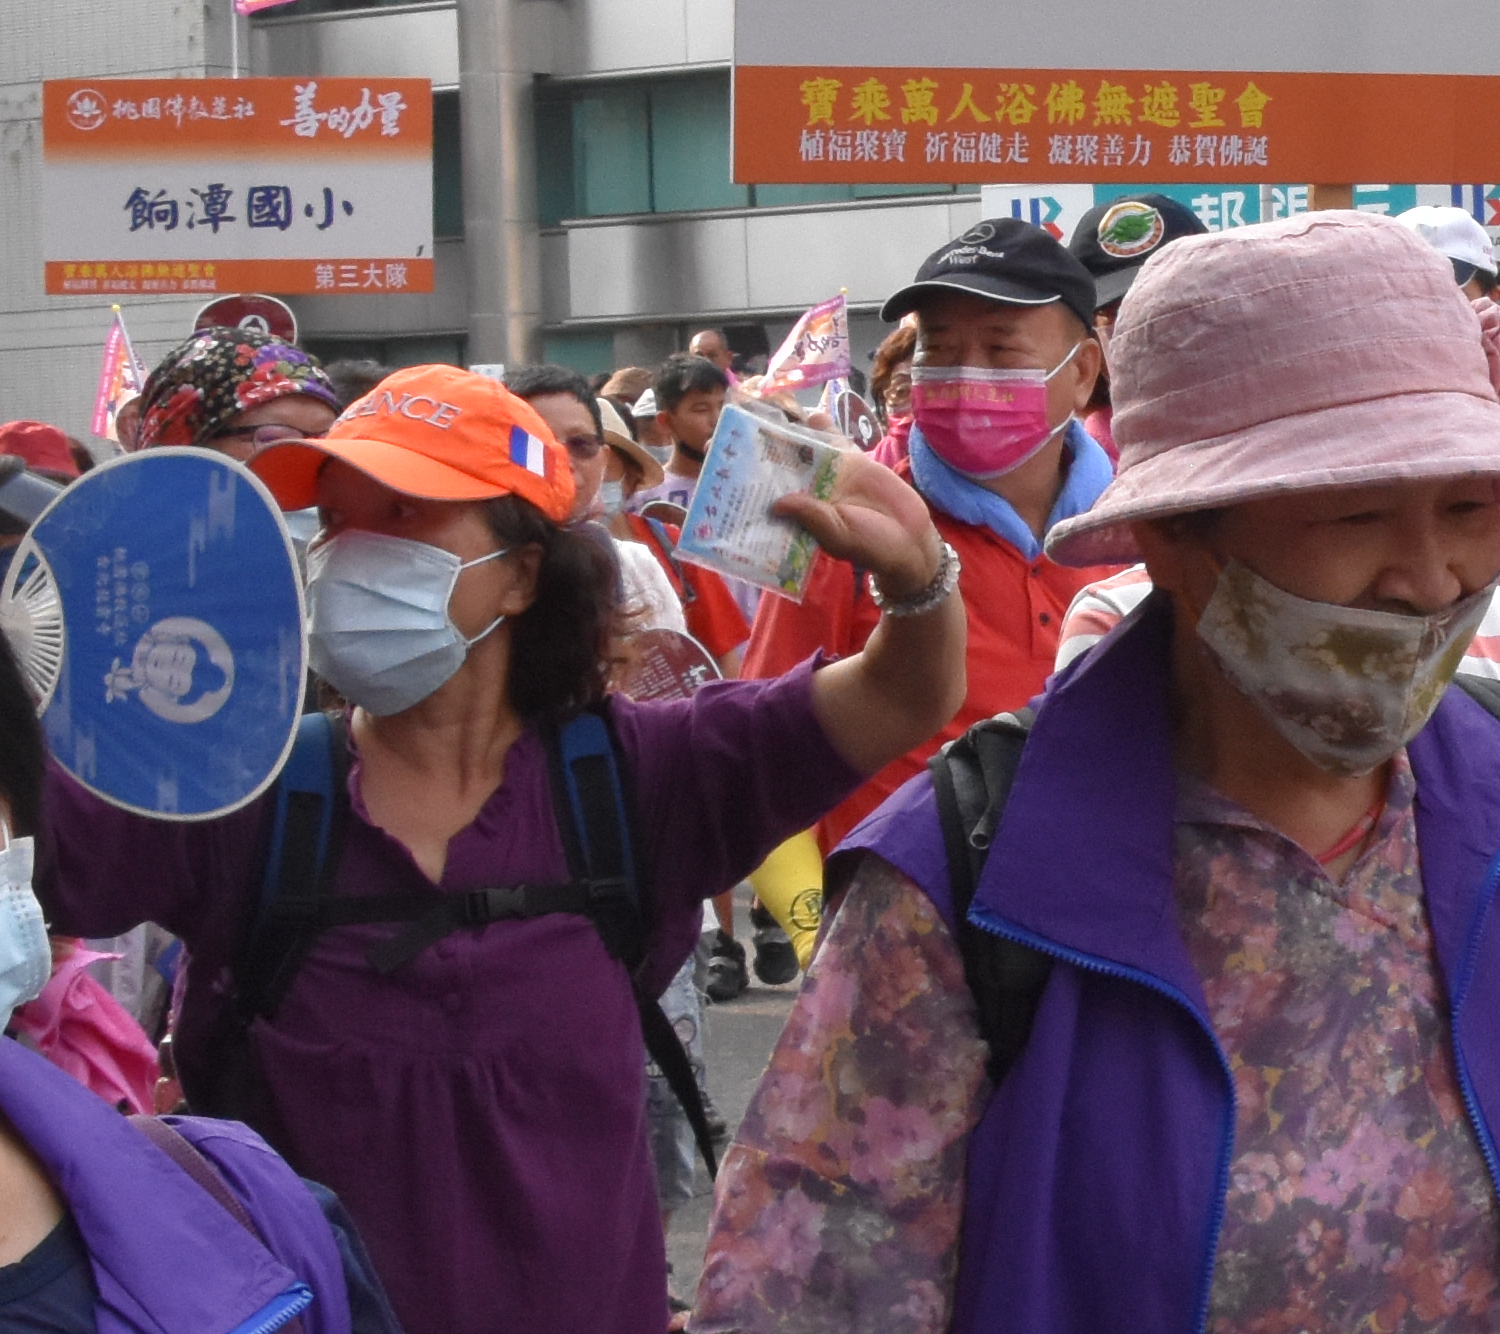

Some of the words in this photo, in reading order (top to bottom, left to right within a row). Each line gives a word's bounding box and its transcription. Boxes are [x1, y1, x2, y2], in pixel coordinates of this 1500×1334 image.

[280, 81, 406, 138] 善的力量
[799, 77, 1274, 128] 寶乘萬人浴佛無遮聖會
[799, 127, 908, 163] 植福聚寶
[924, 131, 1029, 164] 祈福健走
[1048, 133, 1152, 167] 凝聚善力
[1168, 134, 1268, 167] 恭賀佛誕
[124, 182, 354, 233] 餉潭國小
[314, 263, 409, 289] 第三大隊
